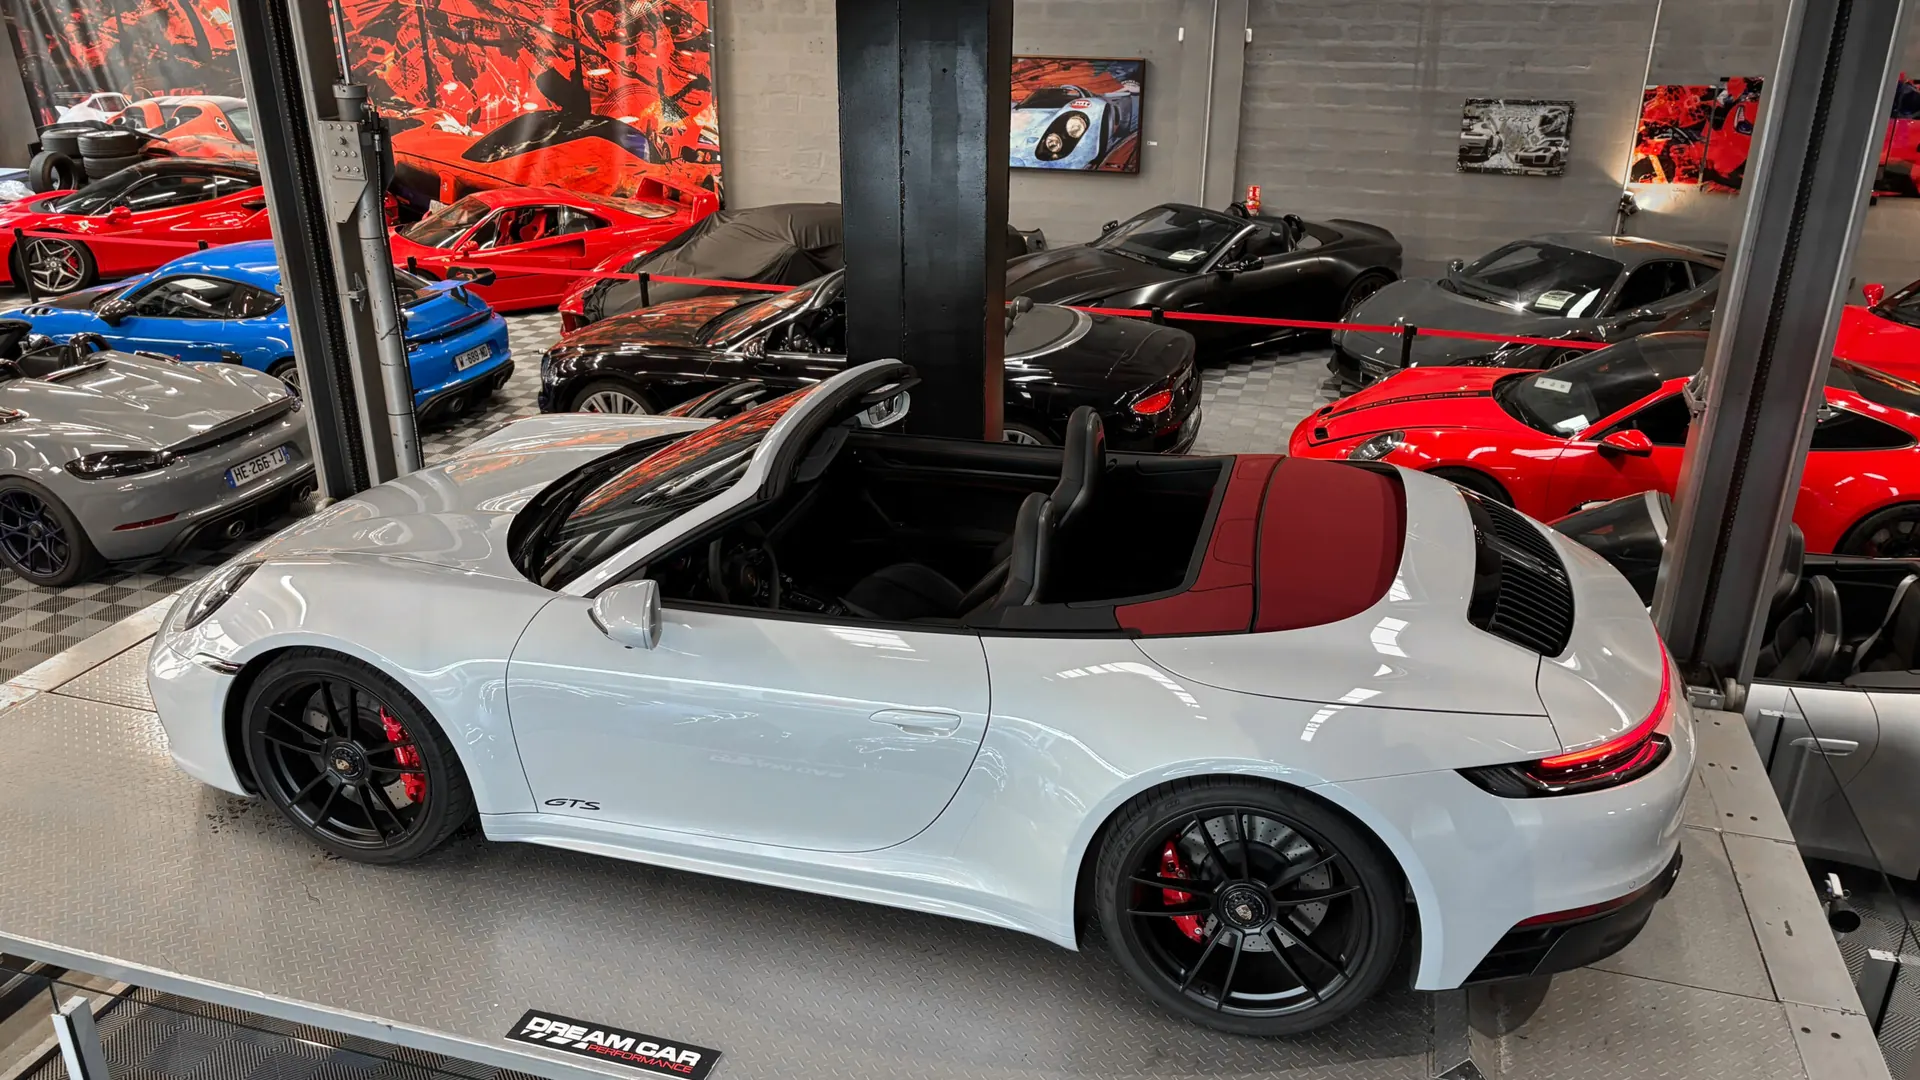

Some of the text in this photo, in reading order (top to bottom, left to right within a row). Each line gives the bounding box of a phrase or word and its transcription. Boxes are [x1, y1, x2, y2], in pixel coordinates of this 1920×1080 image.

[233, 449, 283, 482] HE-266-TJ
[544, 798, 601, 811] GTS
[526, 1017, 701, 1067] DREAM CAR
[586, 1044, 695, 1074] PERFORMANCE
